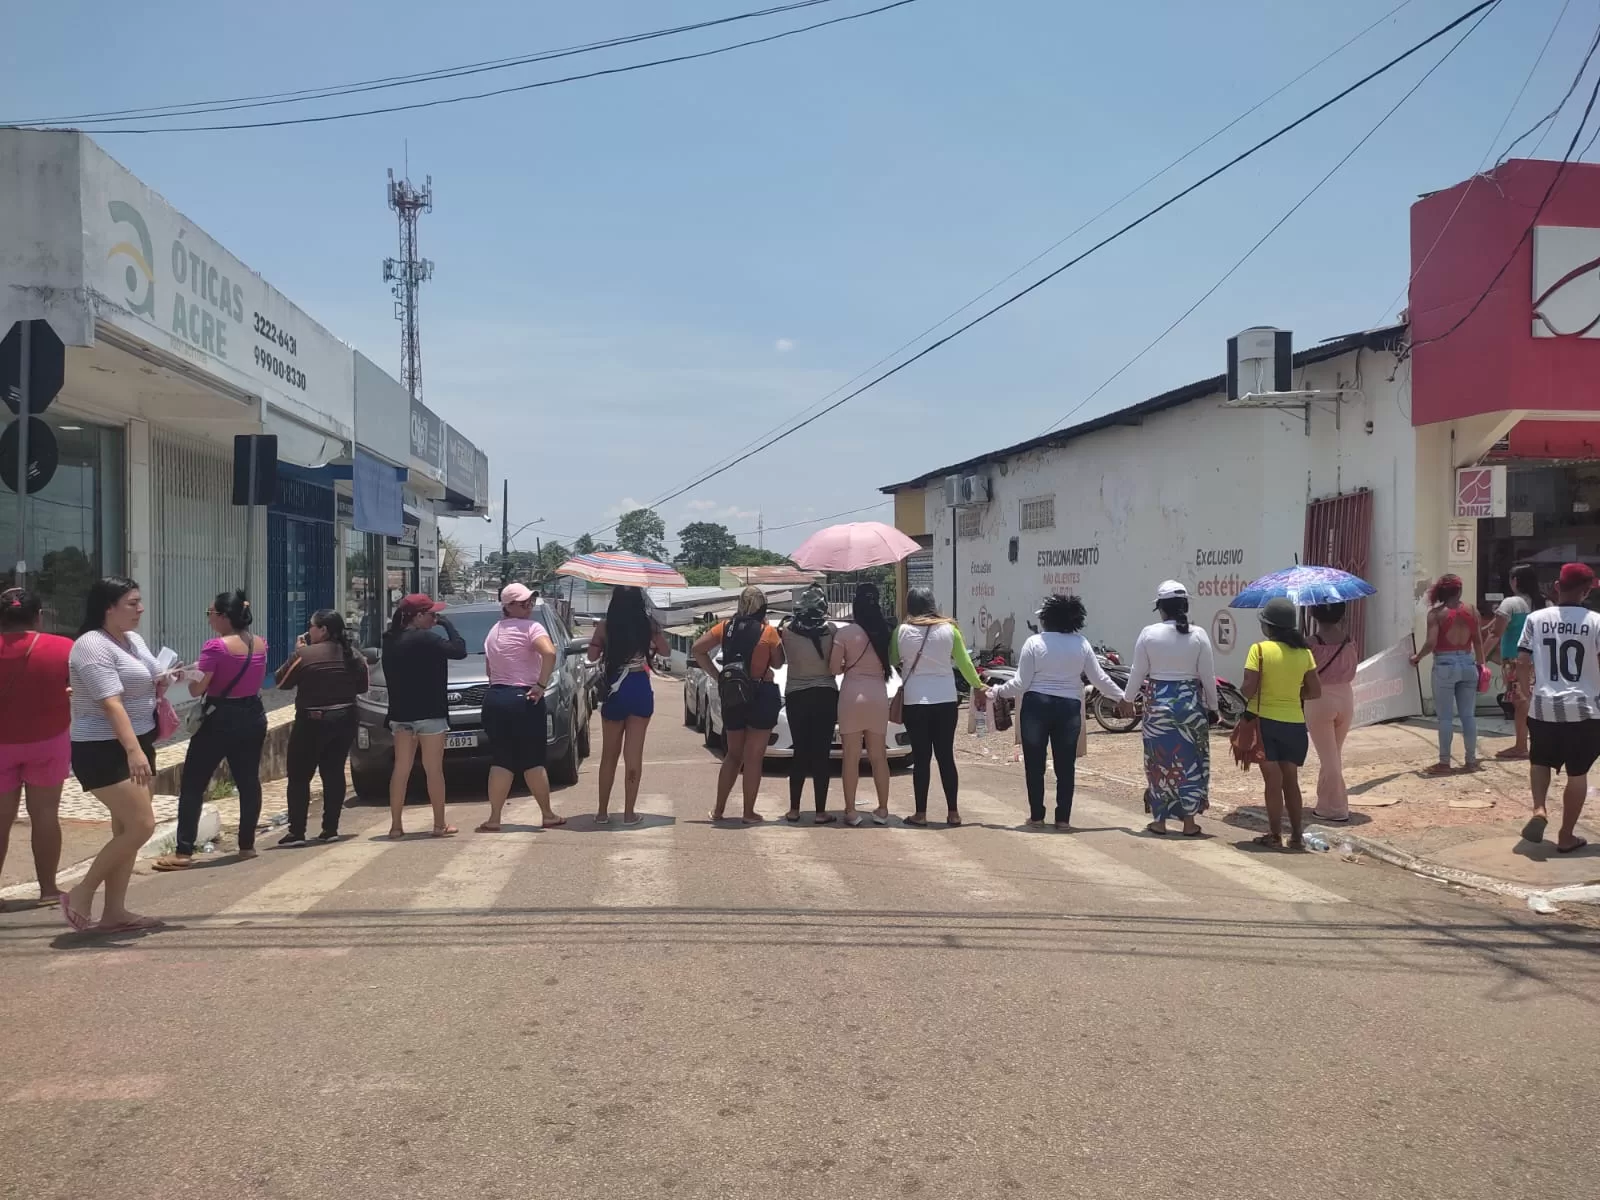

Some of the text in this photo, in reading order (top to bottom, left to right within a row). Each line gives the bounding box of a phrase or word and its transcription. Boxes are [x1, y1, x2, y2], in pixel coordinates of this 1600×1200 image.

[172, 228, 243, 324] ÓTICAS
[172, 292, 227, 360] ACRE
[1458, 505, 1491, 517] DINIZ
[1456, 539, 1466, 553] E
[1037, 547, 1099, 567] ESTACIONAMENTO
[1196, 549, 1244, 566] EXCLUSIVO
[1542, 622, 1589, 636] DYBALA
[1543, 638, 1585, 682] 10
